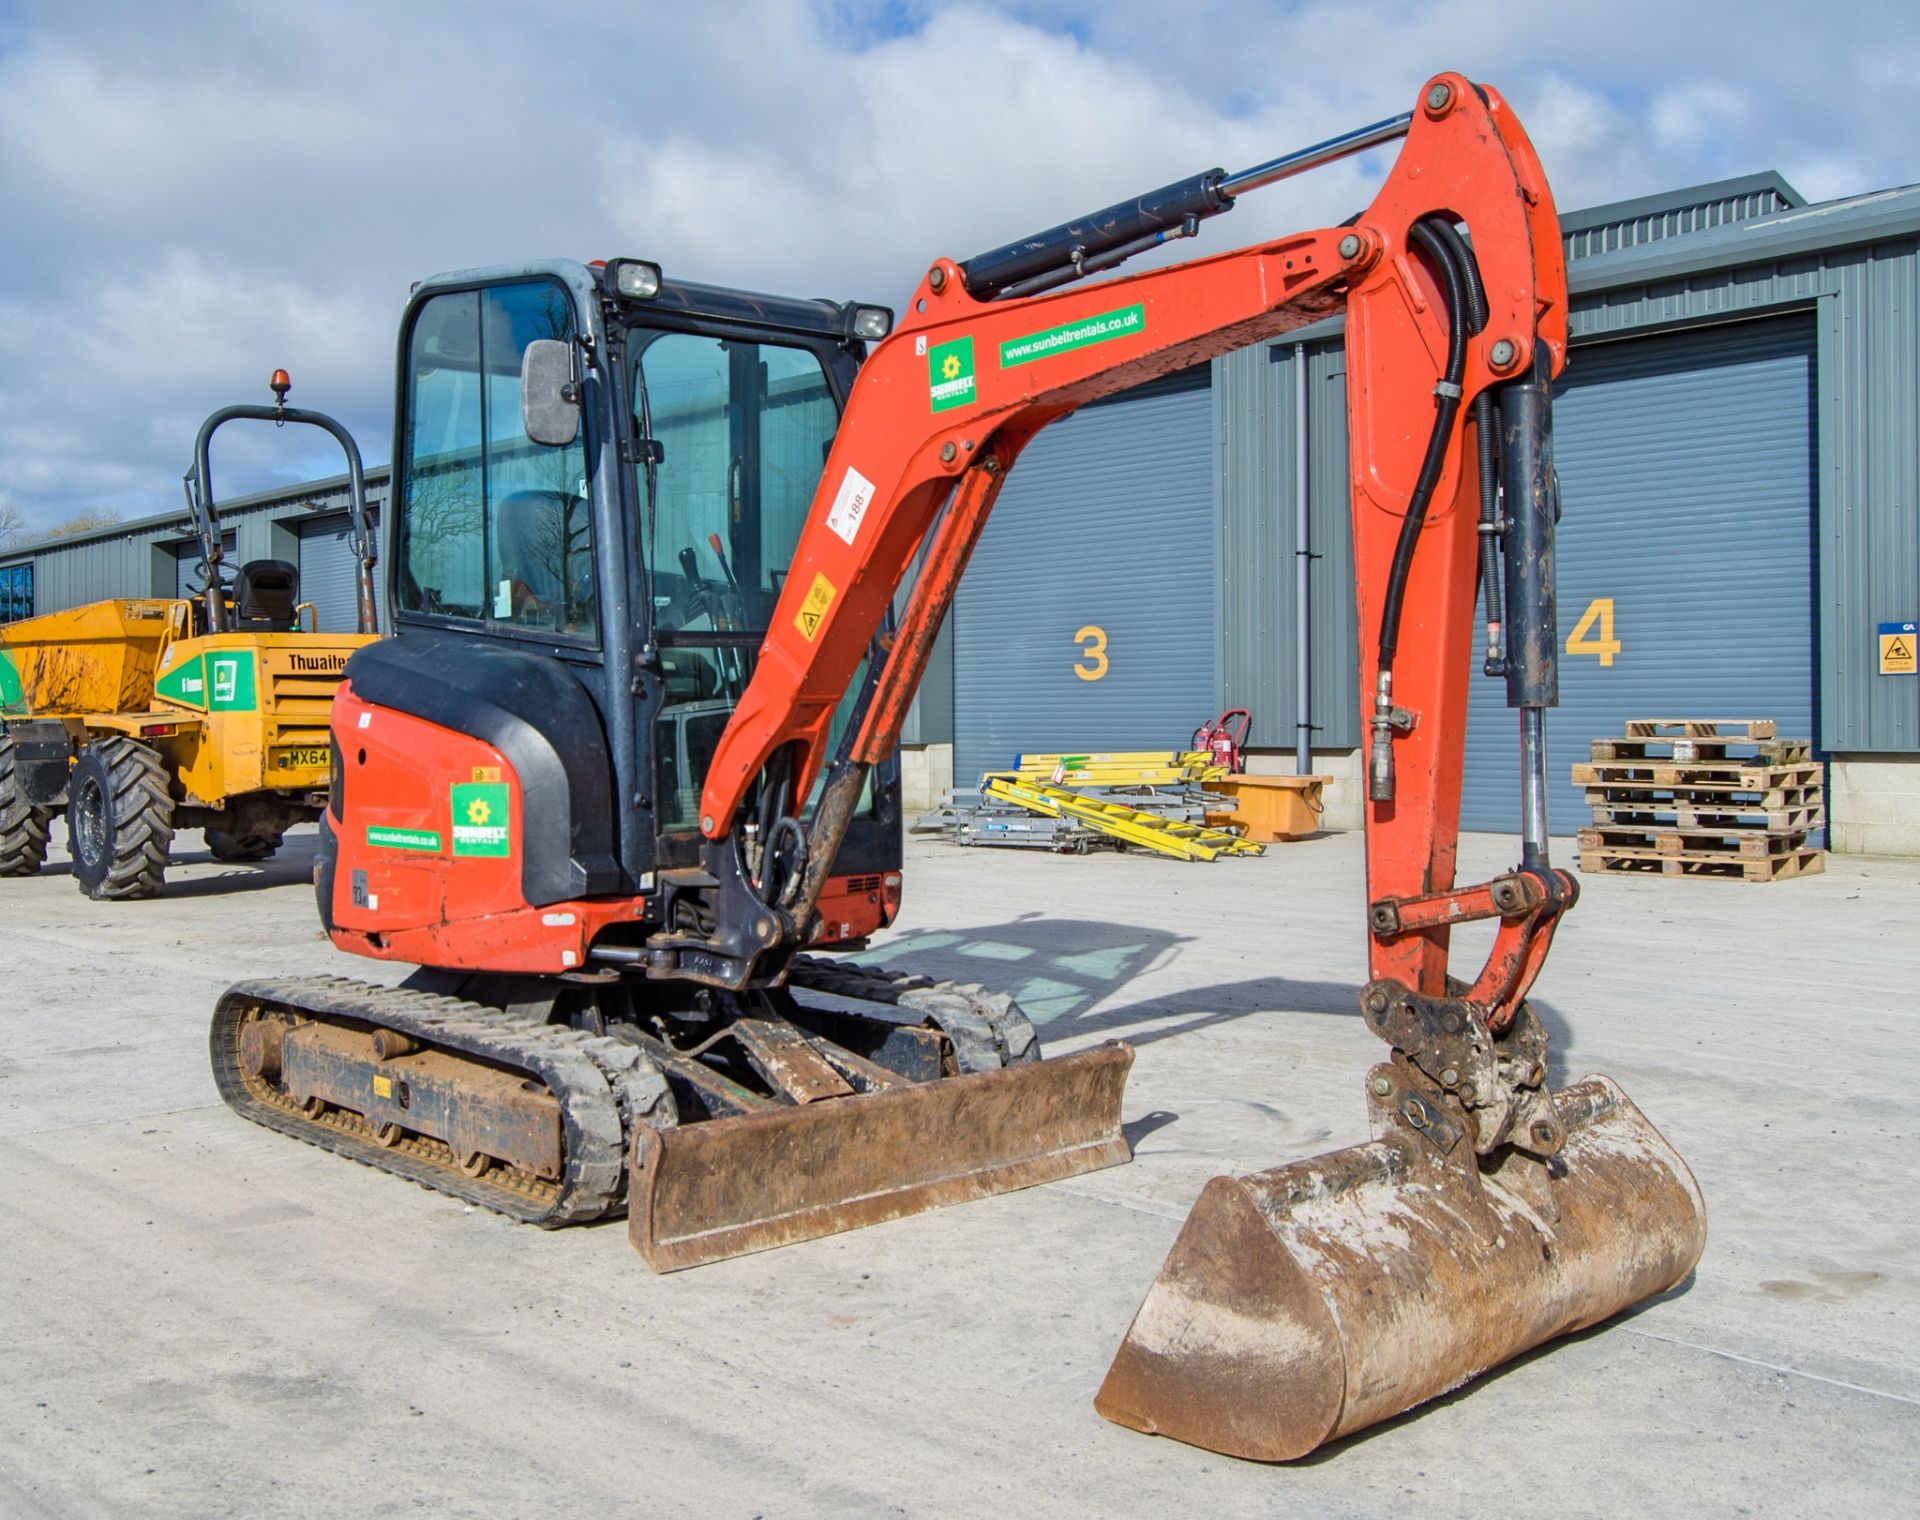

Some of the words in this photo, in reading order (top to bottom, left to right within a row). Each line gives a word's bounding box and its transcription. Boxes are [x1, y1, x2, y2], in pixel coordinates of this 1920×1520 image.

[1005, 312, 1139, 360] www.sunbeltrentals.co.uk
[931, 375, 974, 398] SUNBELT
[848, 494, 864, 521] 188
[1565, 598, 1621, 667] 4
[288, 654, 349, 671] Thwaite
[1074, 625, 1108, 680] 3
[290, 751, 327, 765] MX64
[369, 832, 437, 846] www.sunbeltrentals.co.uk
[453, 826, 506, 839] SUNBELT
